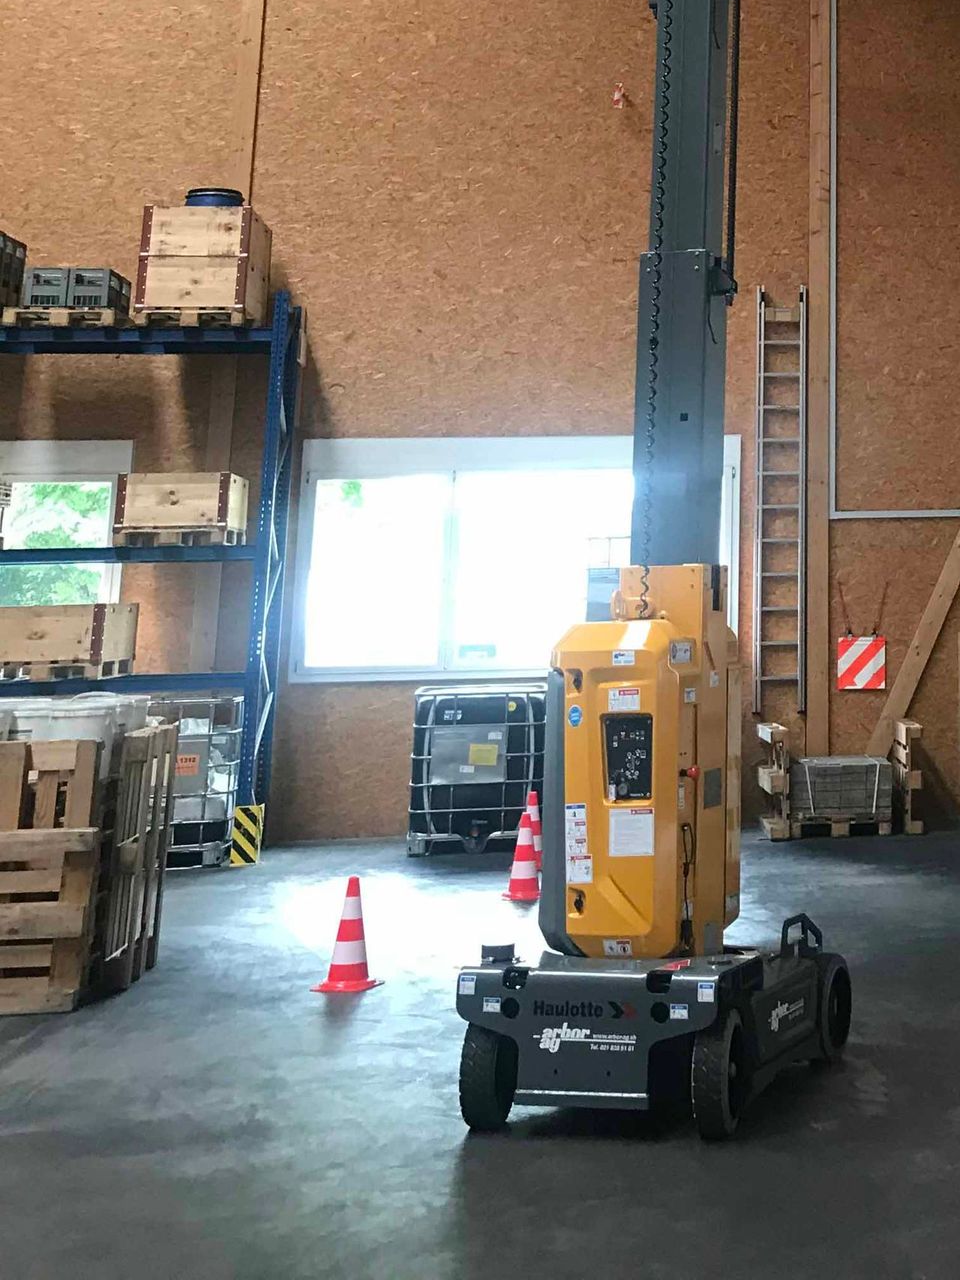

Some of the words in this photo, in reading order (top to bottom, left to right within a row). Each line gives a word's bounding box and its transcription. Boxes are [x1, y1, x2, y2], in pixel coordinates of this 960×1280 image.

[533, 1000, 603, 1018] Haulotte
[541, 1022, 590, 1039] arbor
[539, 1037, 561, 1053] ag
